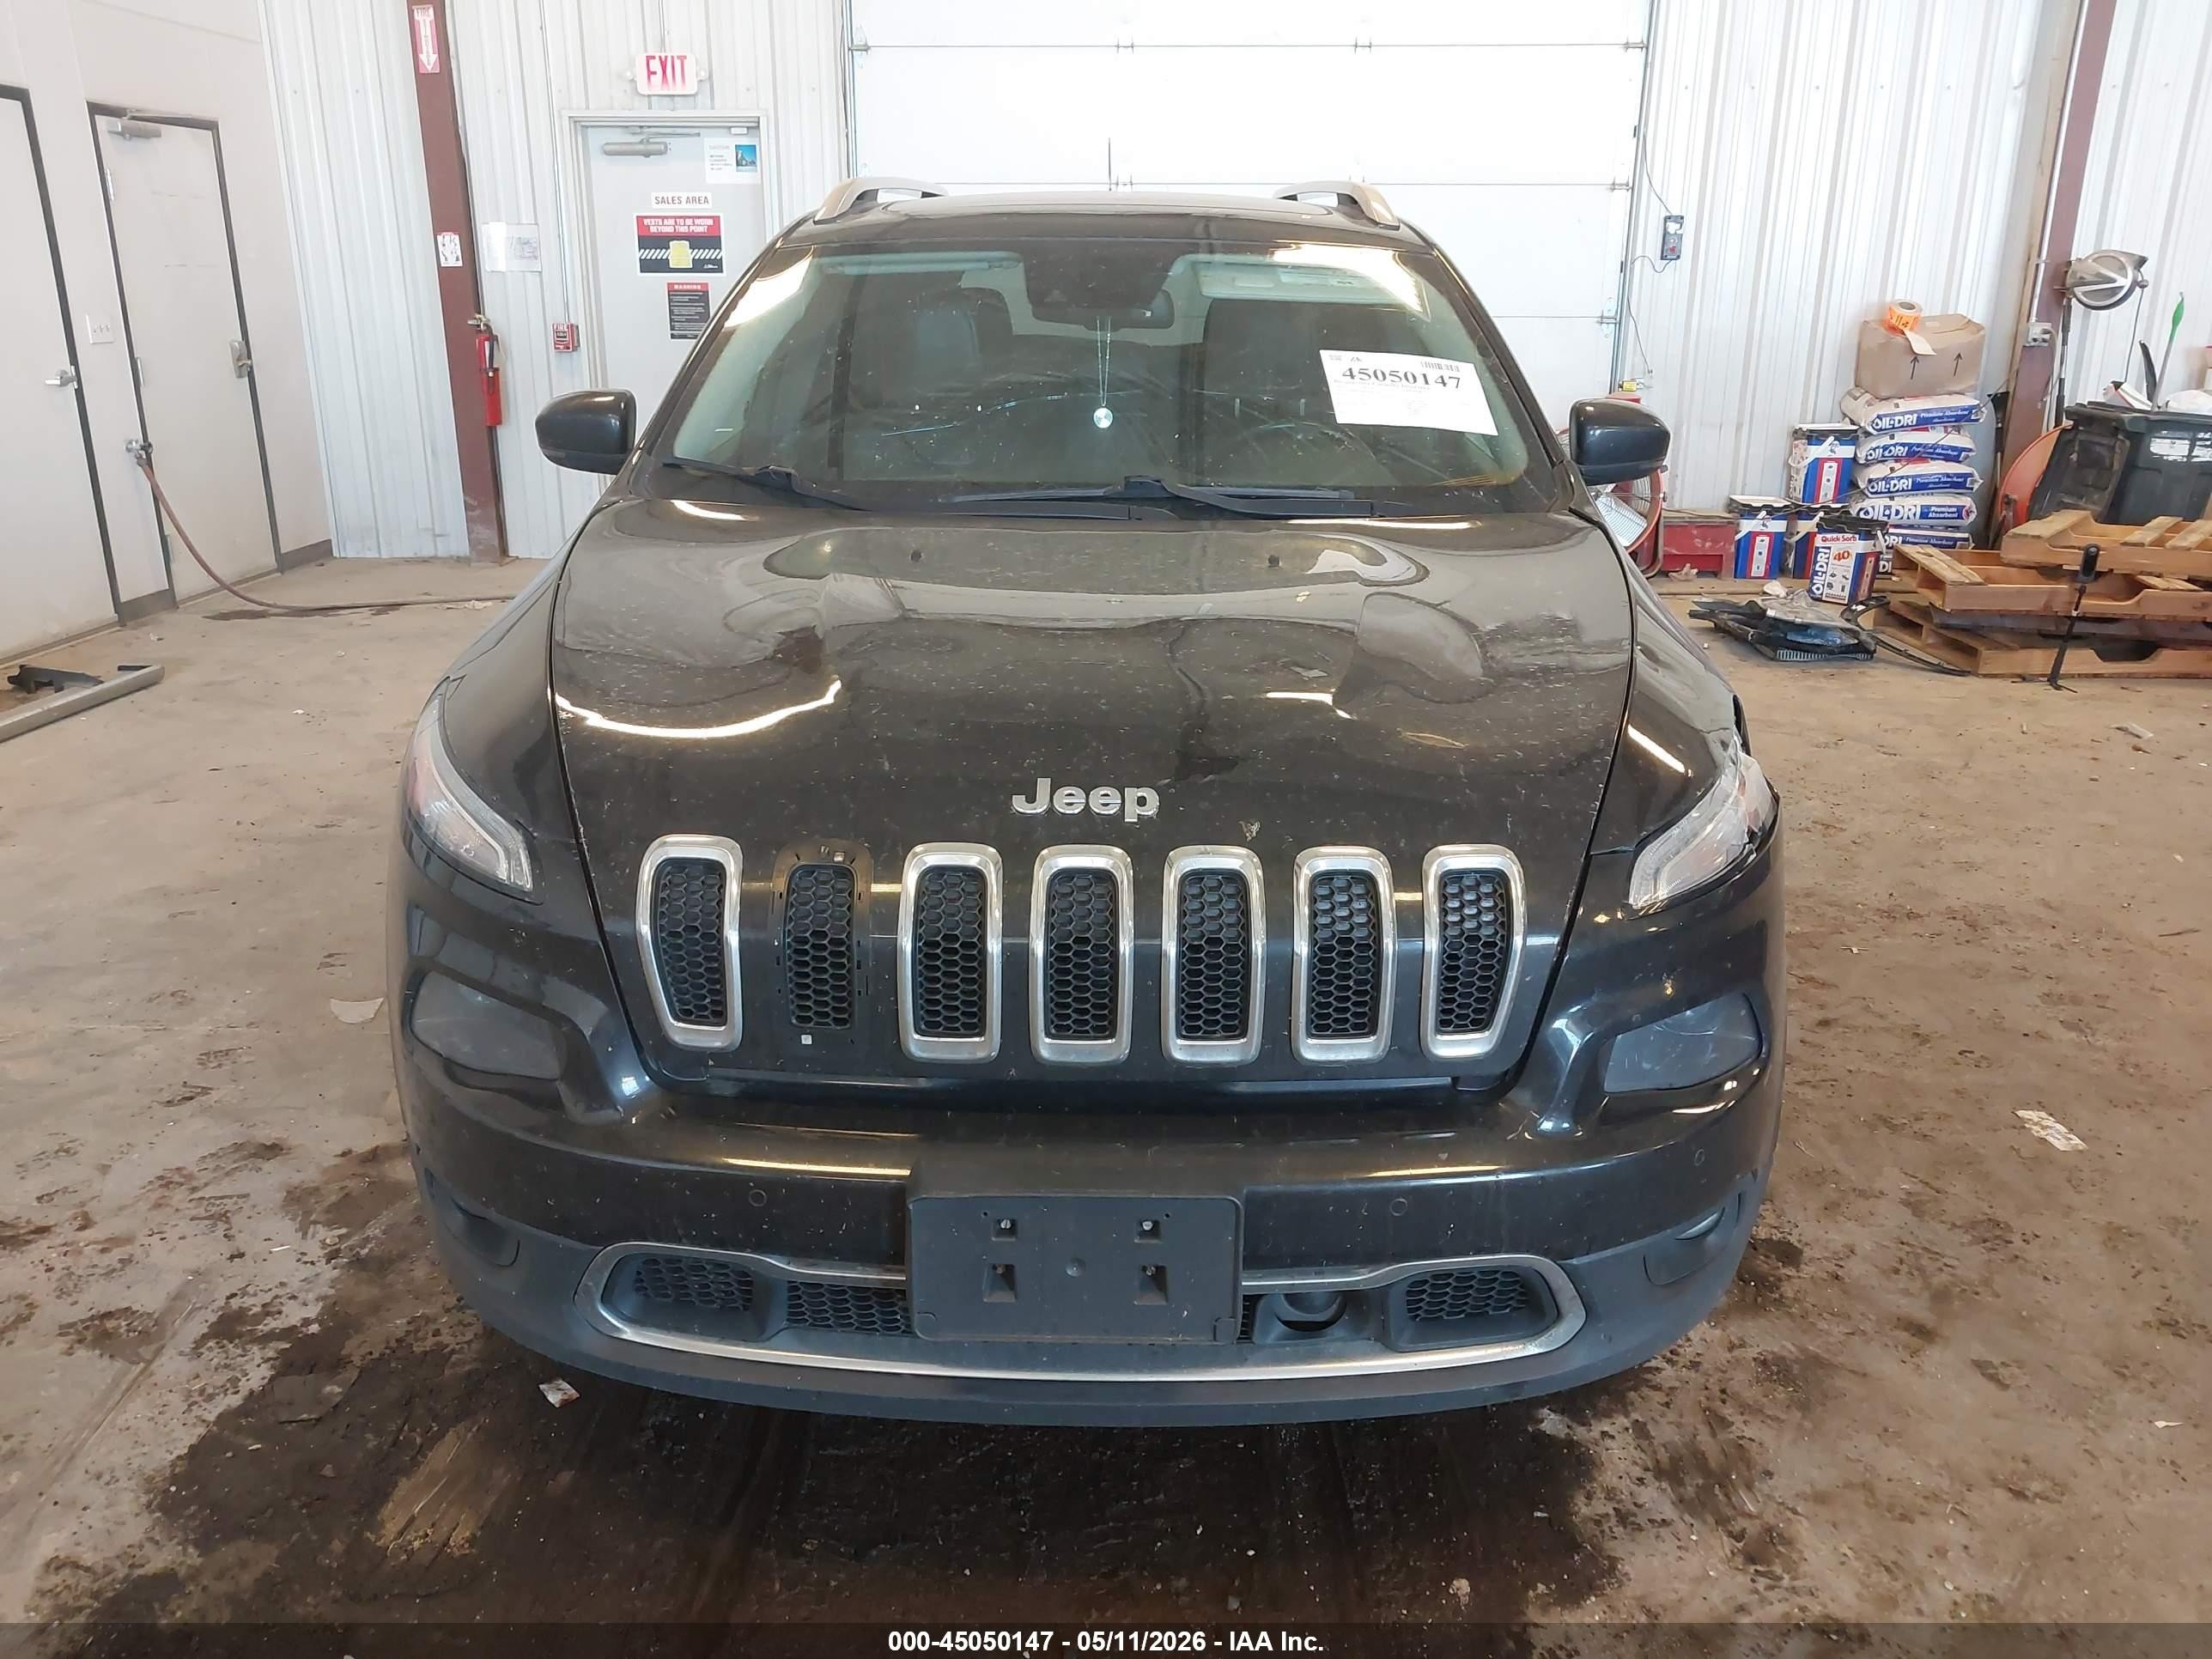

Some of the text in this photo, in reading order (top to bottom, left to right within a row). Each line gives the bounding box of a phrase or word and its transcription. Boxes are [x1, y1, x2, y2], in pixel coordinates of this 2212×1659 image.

[645, 55, 688, 90] EXIT
[654, 196, 709, 206] SALES AREA
[1341, 367, 1462, 390] 45050147
[1841, 534, 1856, 543] Sorb
[1833, 550, 1850, 562] 40
[1012, 777, 1160, 823] Jeep
